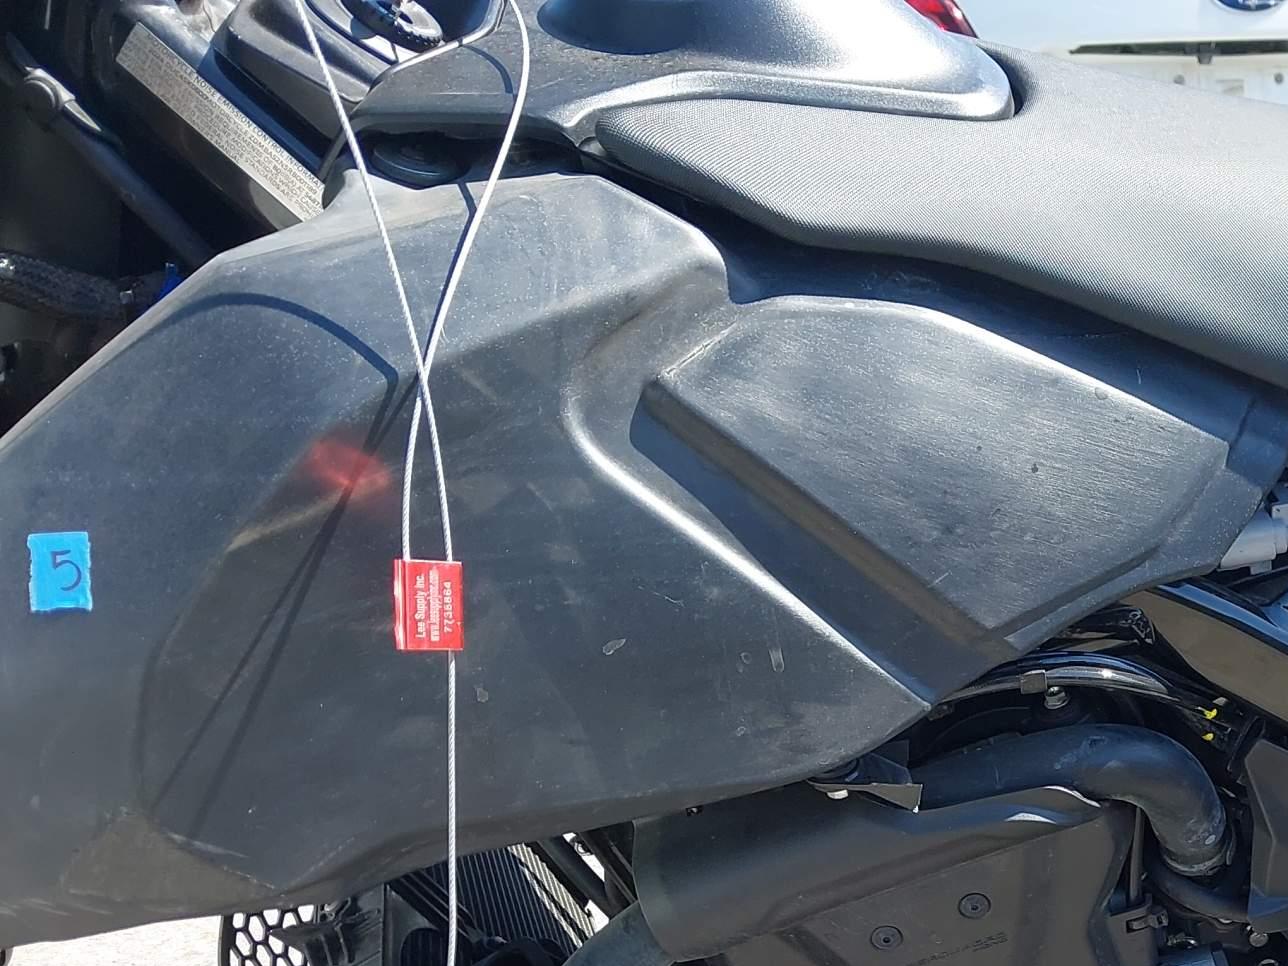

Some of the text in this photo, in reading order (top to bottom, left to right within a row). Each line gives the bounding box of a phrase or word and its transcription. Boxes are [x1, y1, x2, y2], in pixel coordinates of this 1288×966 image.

[193, 75, 217, 98] NOISE
[216, 95, 253, 128] EMISSION
[251, 125, 285, 156] CONTROL
[50, 549, 82, 592] 5
[414, 591, 429, 620] Supply
[415, 620, 426, 638] Lee
